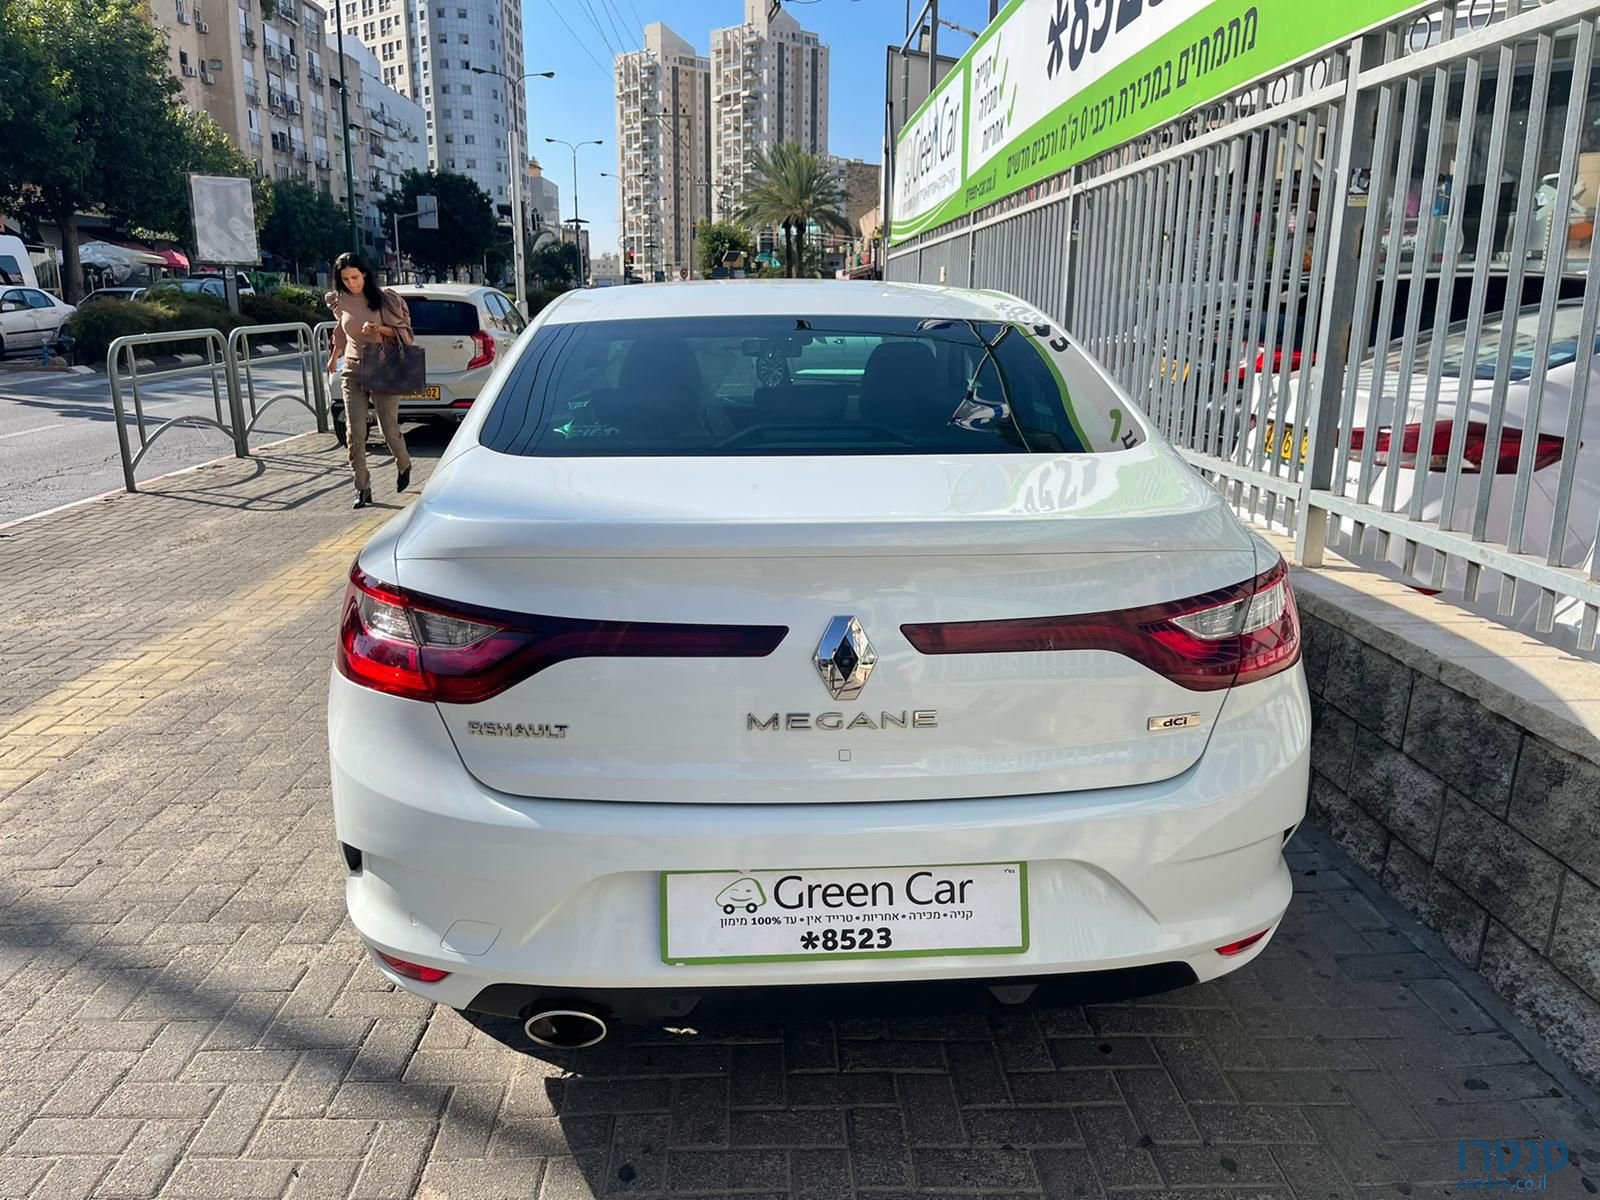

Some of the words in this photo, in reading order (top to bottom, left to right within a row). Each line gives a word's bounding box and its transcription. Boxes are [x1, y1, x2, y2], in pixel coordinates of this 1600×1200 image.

[1176, 6, 1258, 89] מתמחים
[1116, 59, 1172, 122] במכירת
[1091, 95, 1114, 136] רכבי
[939, 95, 960, 162] Car
[981, 115, 1005, 153] אחריות
[1031, 128, 1058, 166] ורכבים
[1006, 145, 1030, 179] חדשים
[467, 720, 569, 739] RENAULT
[746, 709, 938, 731] MEGANE
[773, 875, 894, 910] Green
[905, 871, 973, 905] Car
[720, 916, 748, 928] מימון
[751, 916, 782, 926] 100%
[783, 915, 797, 925] עד
[806, 915, 822, 926] אין
[825, 914, 853, 923] טרייד
[862, 912, 900, 922] אחריות
[909, 910, 941, 921] מכירה
[950, 909, 973, 921] קניה
